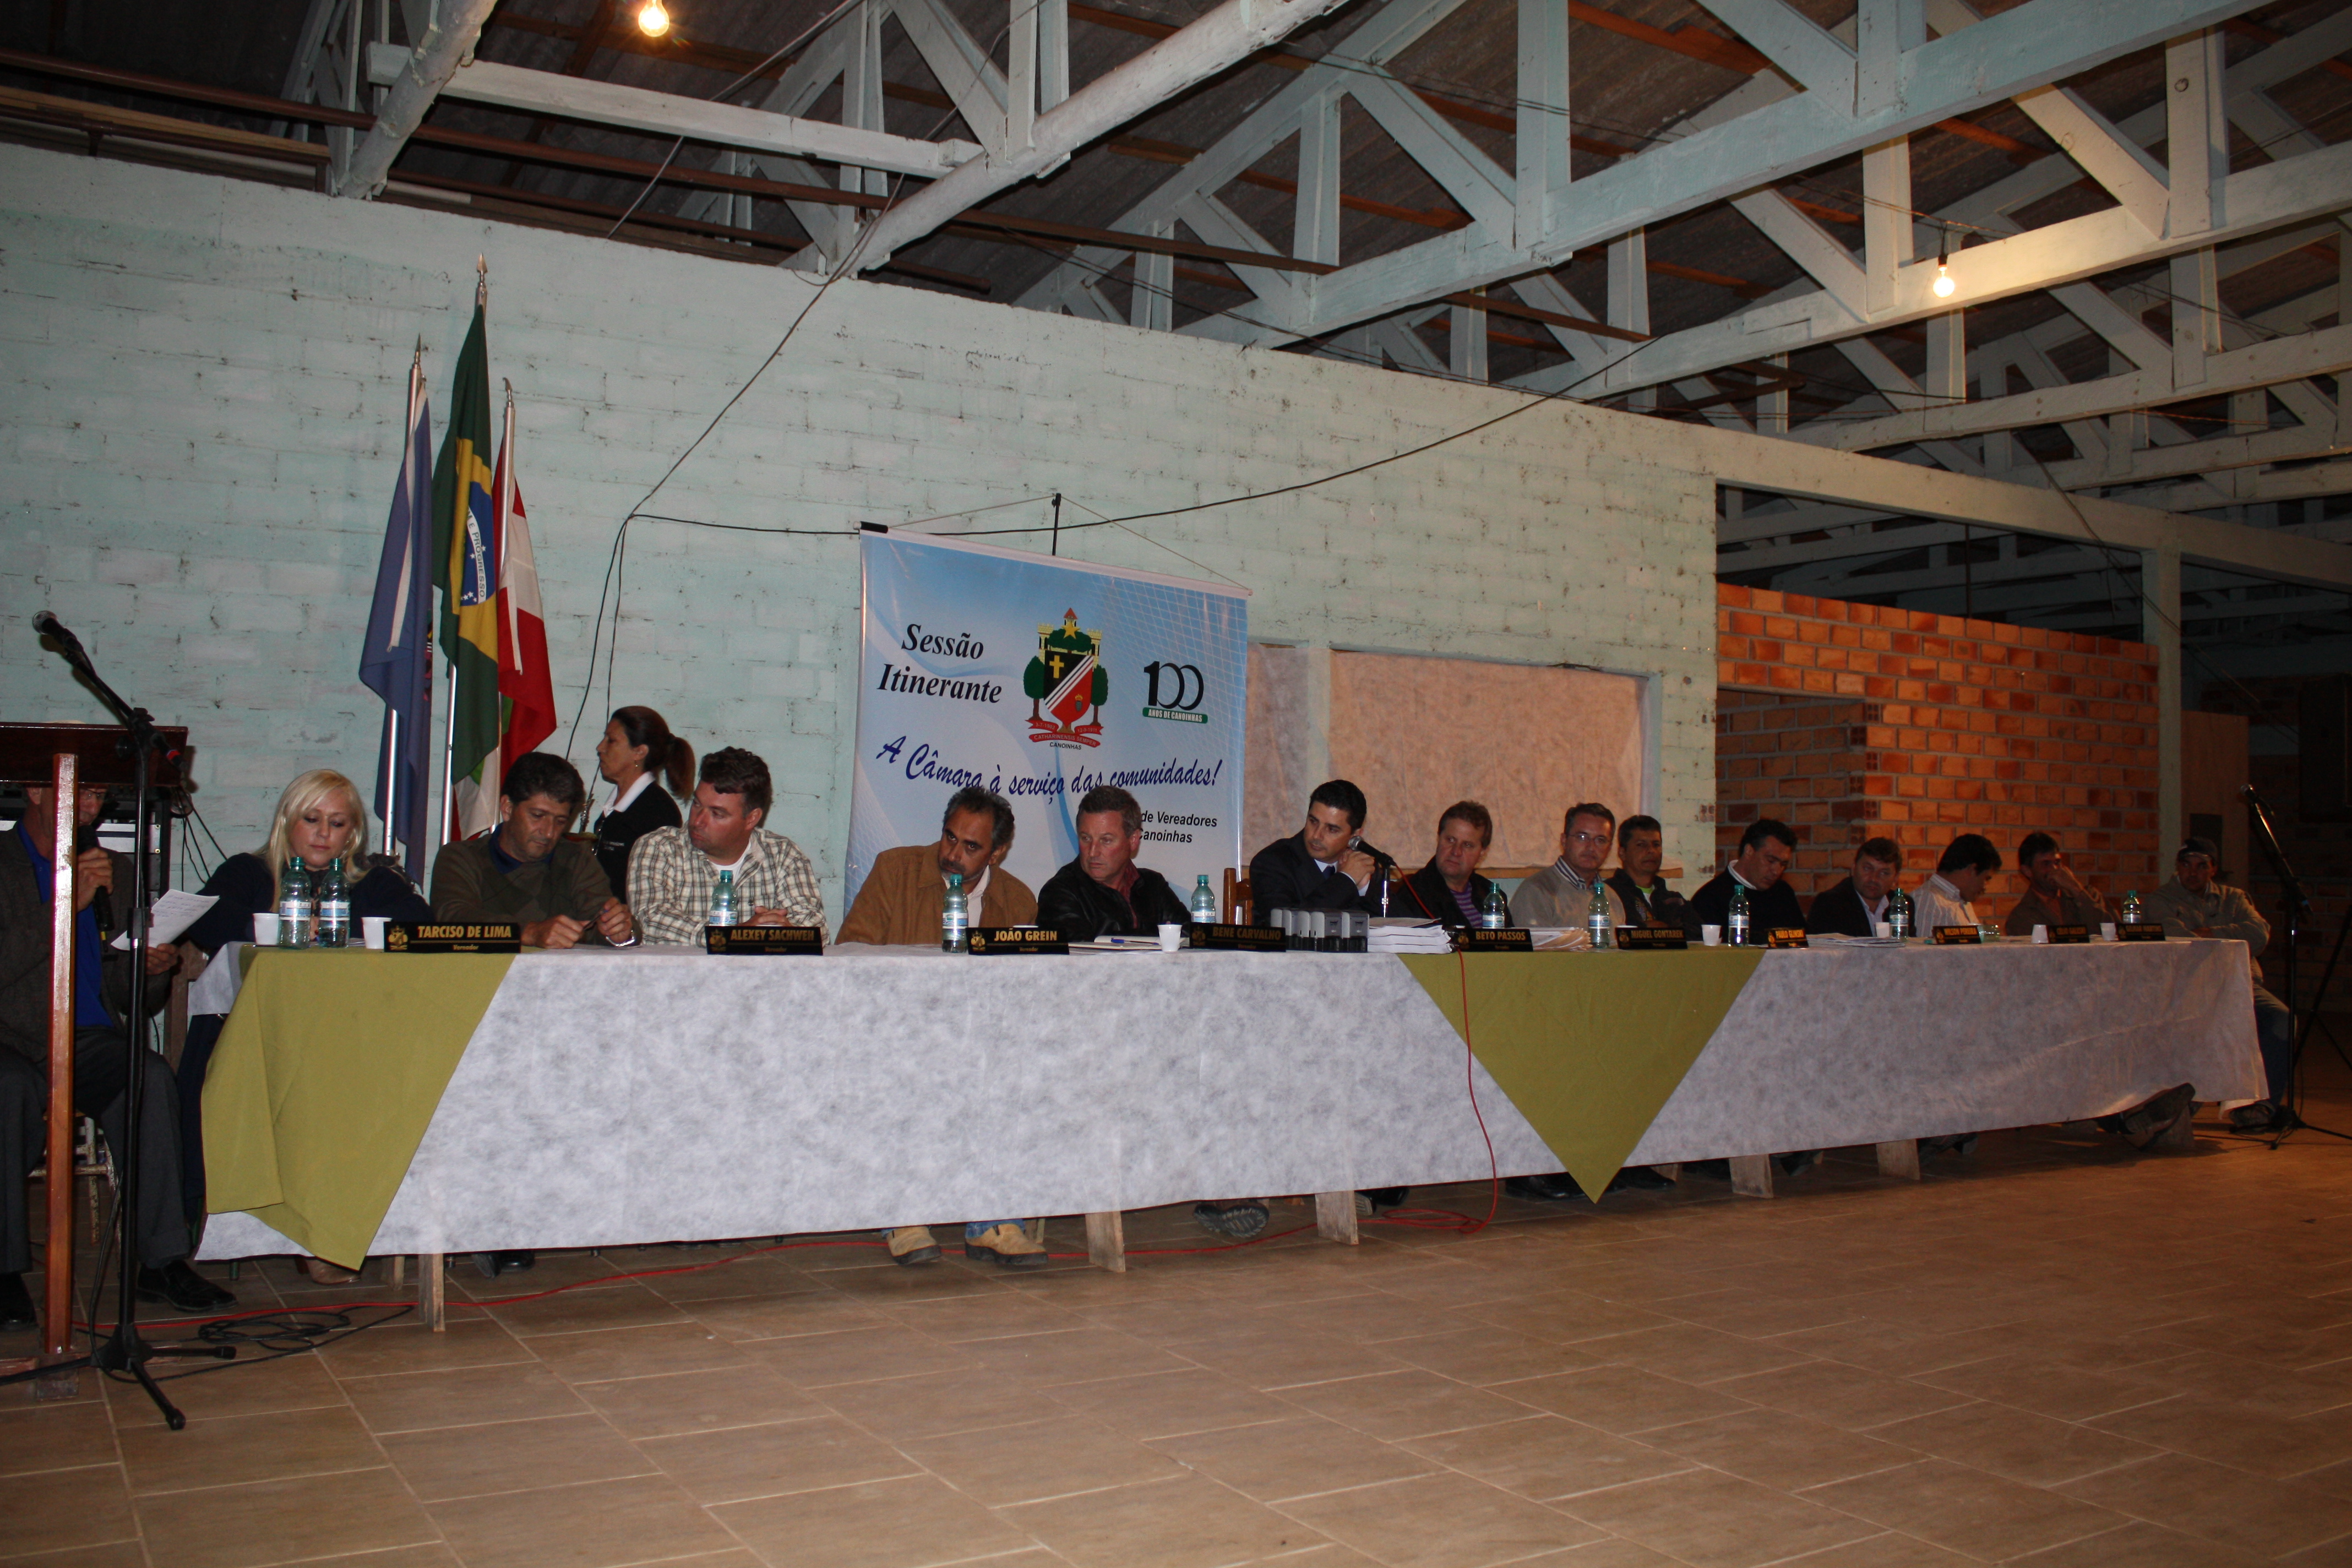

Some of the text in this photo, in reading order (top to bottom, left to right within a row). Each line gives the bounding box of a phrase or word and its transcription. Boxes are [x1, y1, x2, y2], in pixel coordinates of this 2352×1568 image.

[472, 532, 486, 597] PROGRESSO
[901, 624, 984, 659] Sessão
[876, 663, 1002, 703] Itinerante
[1144, 661, 1204, 711] 100
[1148, 709, 1202, 722] ANOS DE CANOINHAS
[1076, 737, 1097, 746] SEMPER
[876, 736, 1223, 804] A Câmara à serviço das comunidades!
[1157, 811, 1218, 827] Vereadores
[417, 925, 512, 938] TARCISO DE LIMA
[730, 929, 814, 941] ALEXEY SACHWEH
[994, 928, 1058, 941] JOÃO GREIN
[1212, 926, 1282, 940] BENE CARVALHO
[1476, 931, 1527, 940] BETO PASSOS
[1631, 930, 1653, 939] MIGUEL
